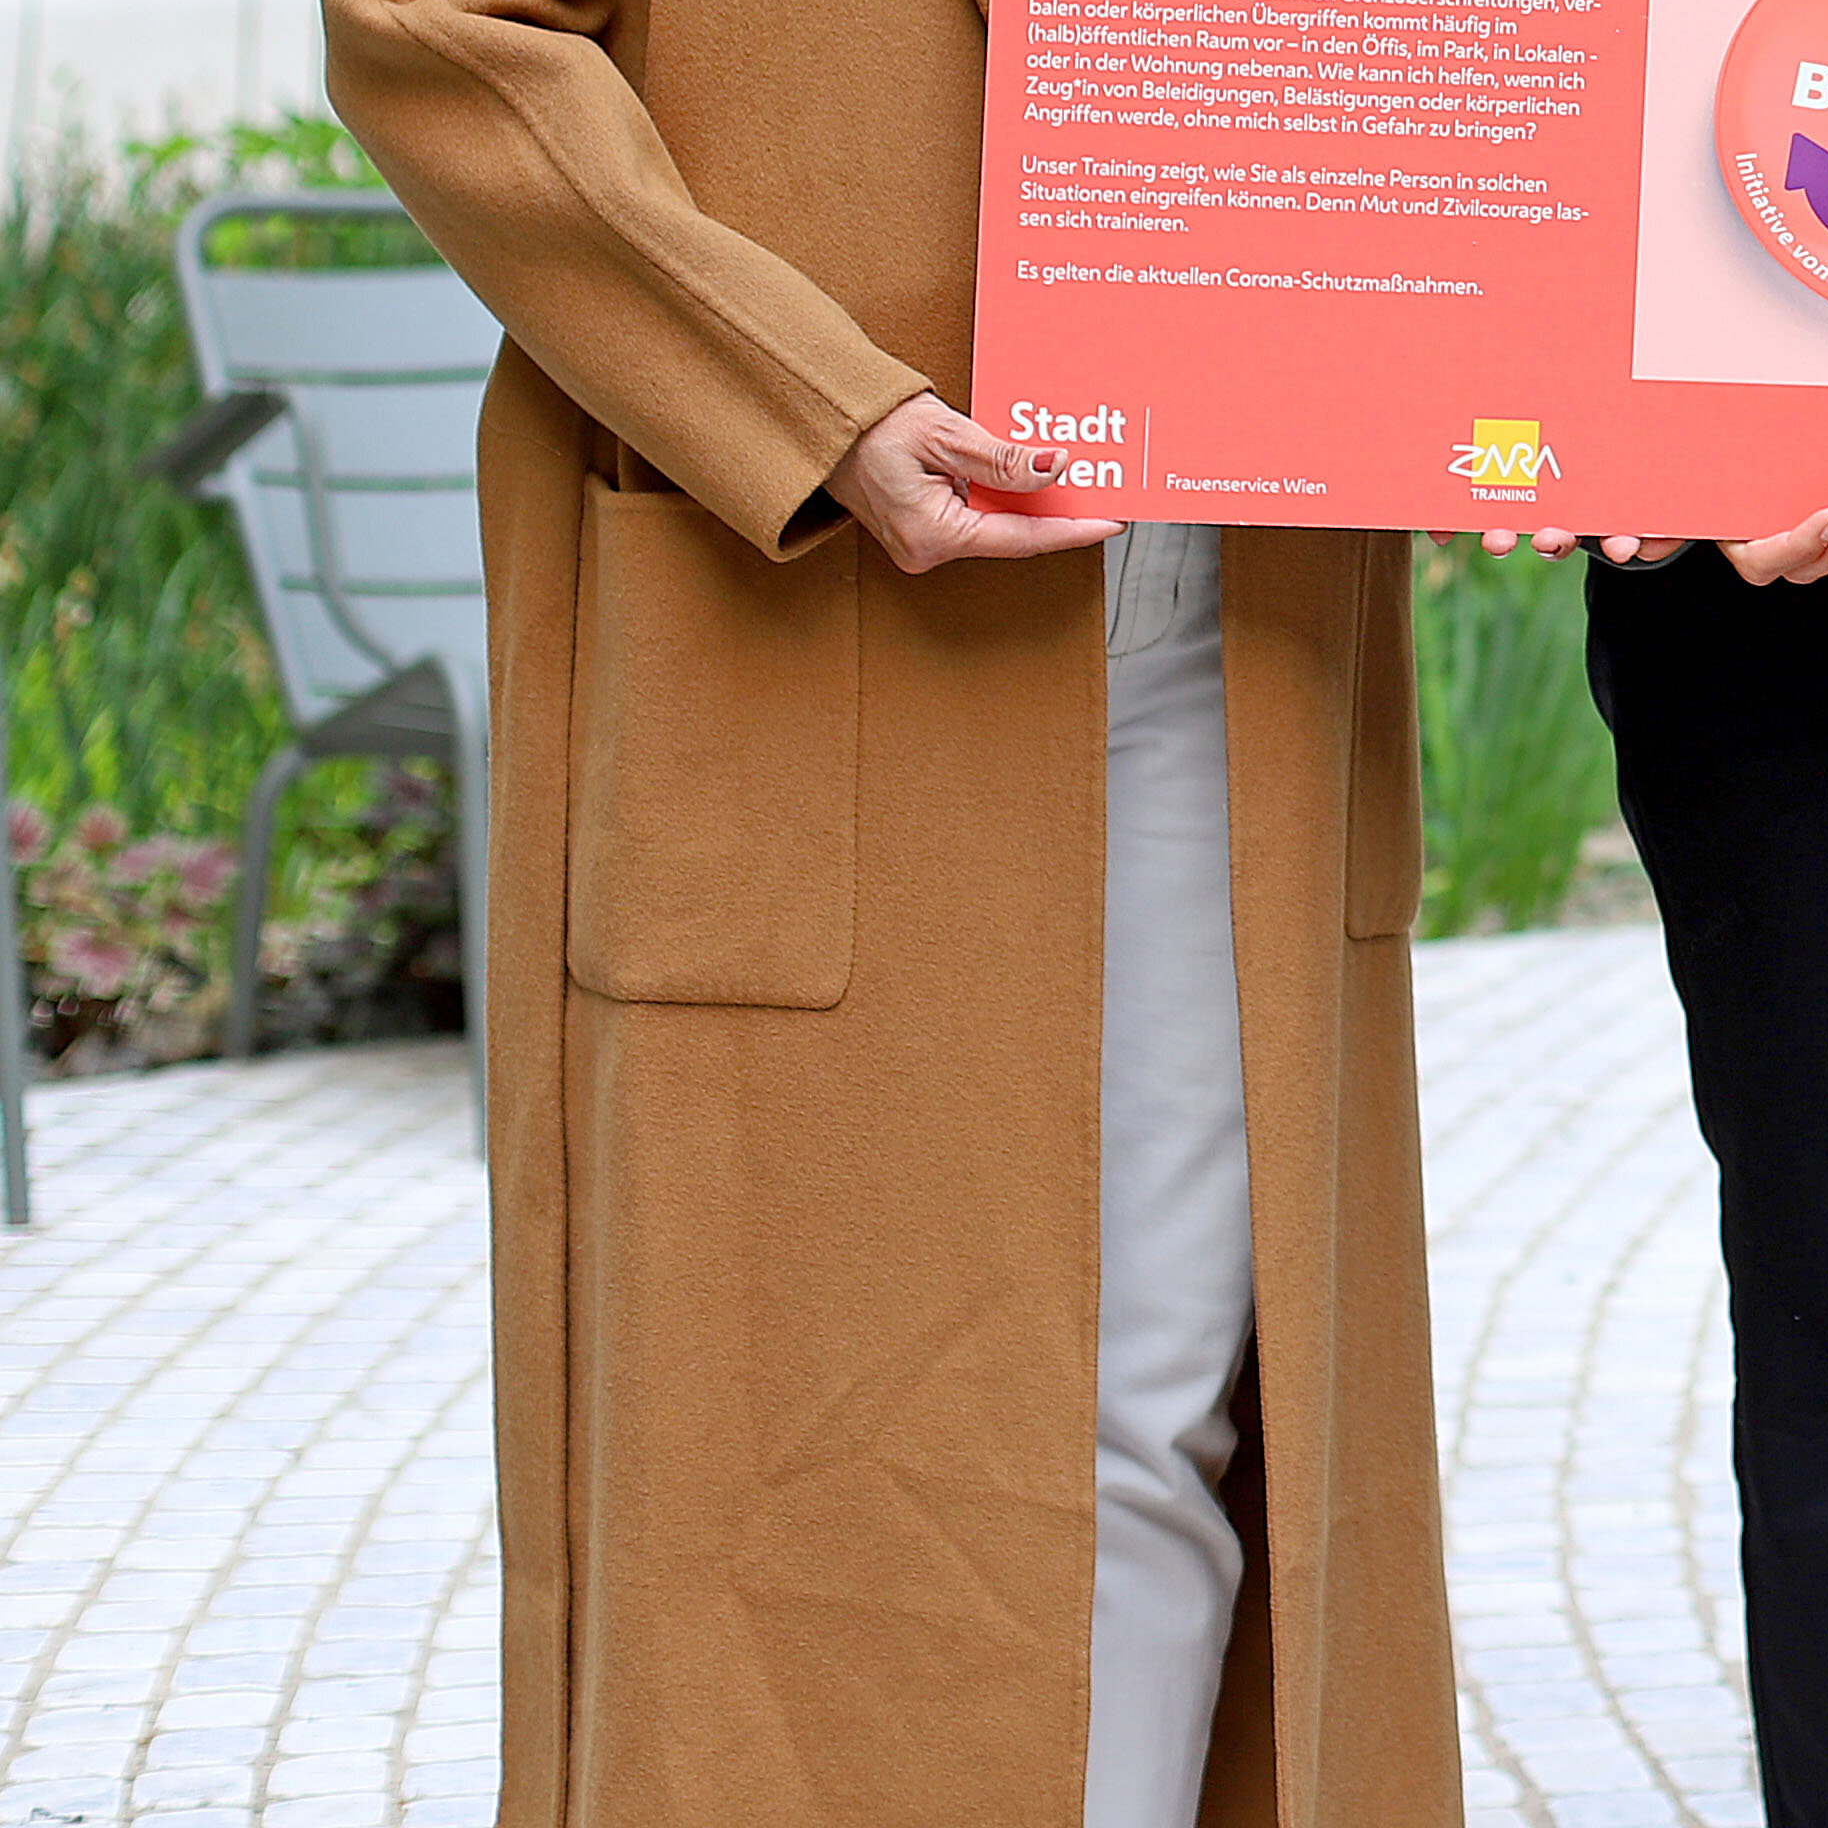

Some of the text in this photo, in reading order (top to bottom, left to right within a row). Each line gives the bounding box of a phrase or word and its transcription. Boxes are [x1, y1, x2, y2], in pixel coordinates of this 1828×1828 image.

[1084, 0, 1129, 19] oder
[1132, 0, 1248, 26] körperlichen
[1252, 2, 1359, 32] Übergriffen
[1363, 10, 1429, 32] kommt
[1432, 13, 1491, 39] häufig
[1494, 16, 1518, 35] im
[1027, 21, 1192, 48] (halb)öffentlichen
[1196, 29, 1249, 50] Raum
[1252, 37, 1284, 52] vor
[1301, 34, 1319, 53] in
[1322, 35, 1359, 55] den
[1362, 32, 1412, 60] Öffis,
[1416, 39, 1440, 58] im
[1443, 40, 1489, 64] Park,
[1493, 42, 1510, 61] in
[1514, 43, 1585, 64] Lokalen
[1026, 49, 1585, 90] oder in der Wohnung nebenan. Wie kann ich helfen, wenn ich
[1102, 83, 1138, 98] von
[1142, 80, 1279, 108] Beleidigungen,
[1283, 86, 1415, 114] Belästigungen
[1418, 91, 1463, 111] oder
[1465, 93, 1580, 118] körperlichen
[1023, 102, 1537, 145] Angriffen werde, ohne mich selbst in Gefahr zu bringen?
[1022, 154, 1548, 193] Unser Training zeigt, wie Sie als einzelne Person in solchen
[1020, 180, 1590, 224] Situationen eingreifen können. Denn Mut und Zivilcourage las-
[1735, 153, 1794, 245] Initiative
[1019, 209, 1189, 232] sen sich trainieren.
[1017, 260, 1484, 296] Es gelten die aktuellen Corona-Schutzmaßnahmen.
[1009, 401, 1127, 444] Stadt
[1447, 442, 1562, 480] ZARA
[1166, 473, 1327, 495] Frauenservice Wien
[1469, 487, 1537, 502] TRAINING
